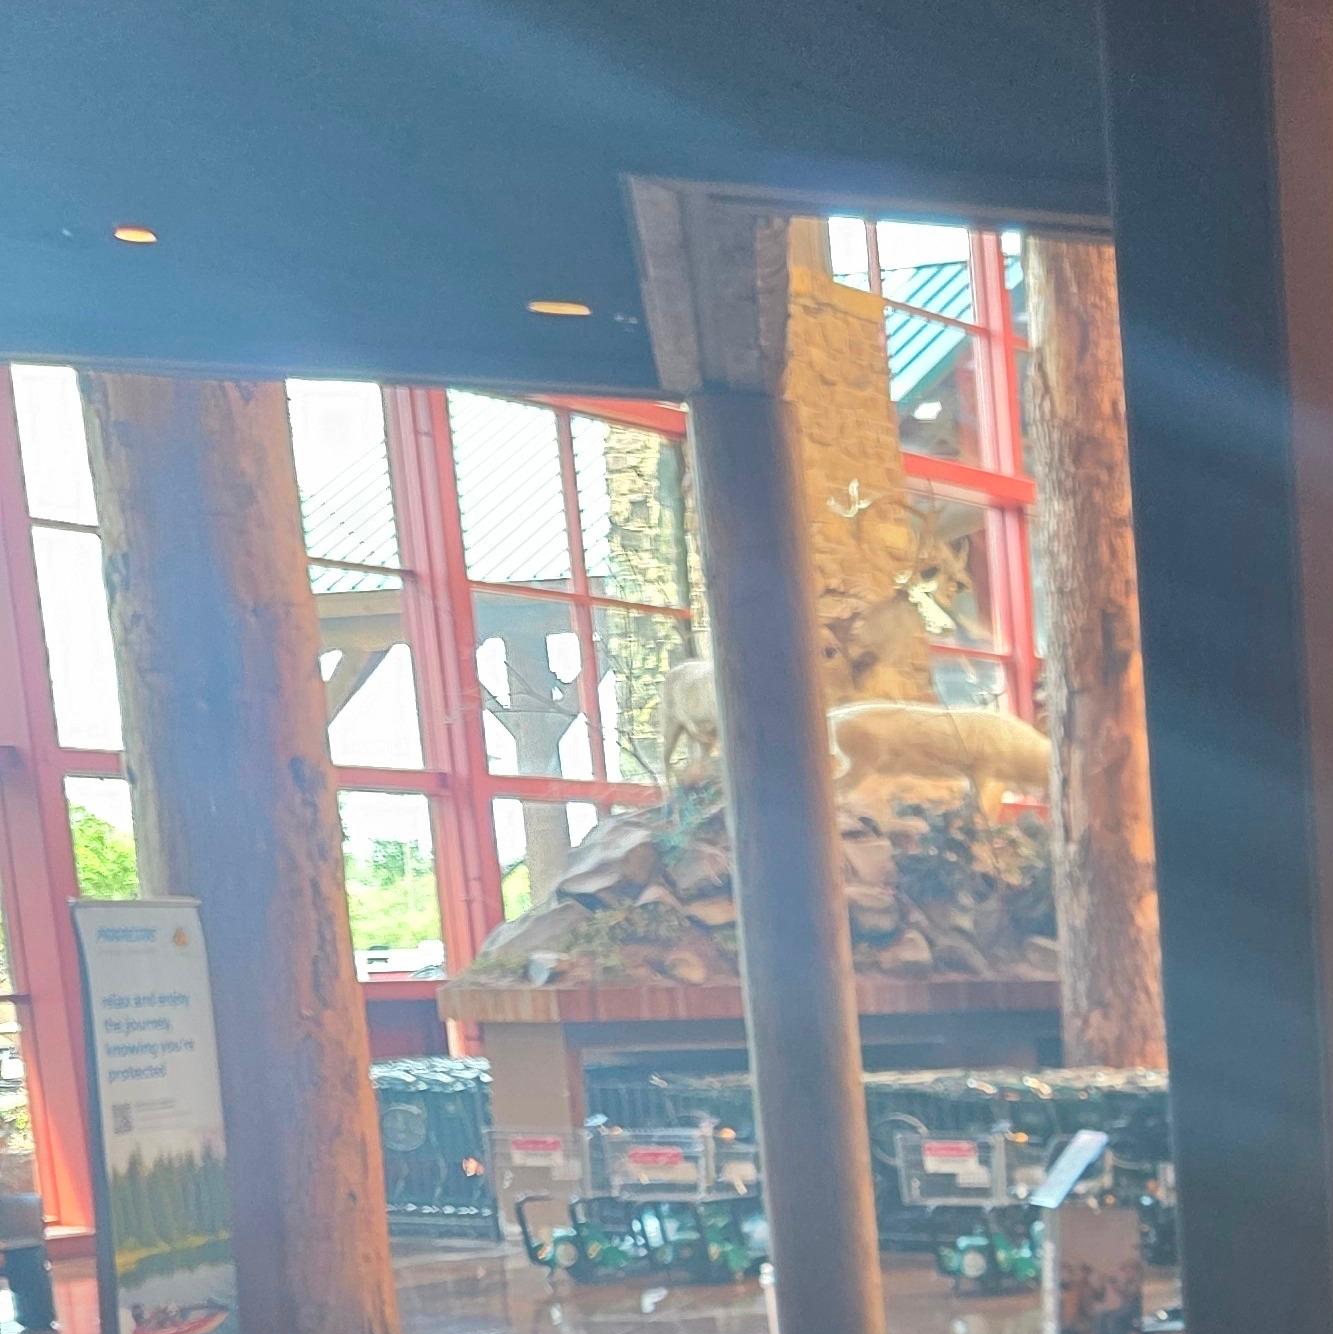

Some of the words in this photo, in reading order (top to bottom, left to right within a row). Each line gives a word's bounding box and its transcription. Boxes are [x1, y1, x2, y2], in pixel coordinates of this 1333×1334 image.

[133, 993, 155, 1008] and
[104, 1019, 123, 1034] the
[105, 1043, 159, 1059] knowing
